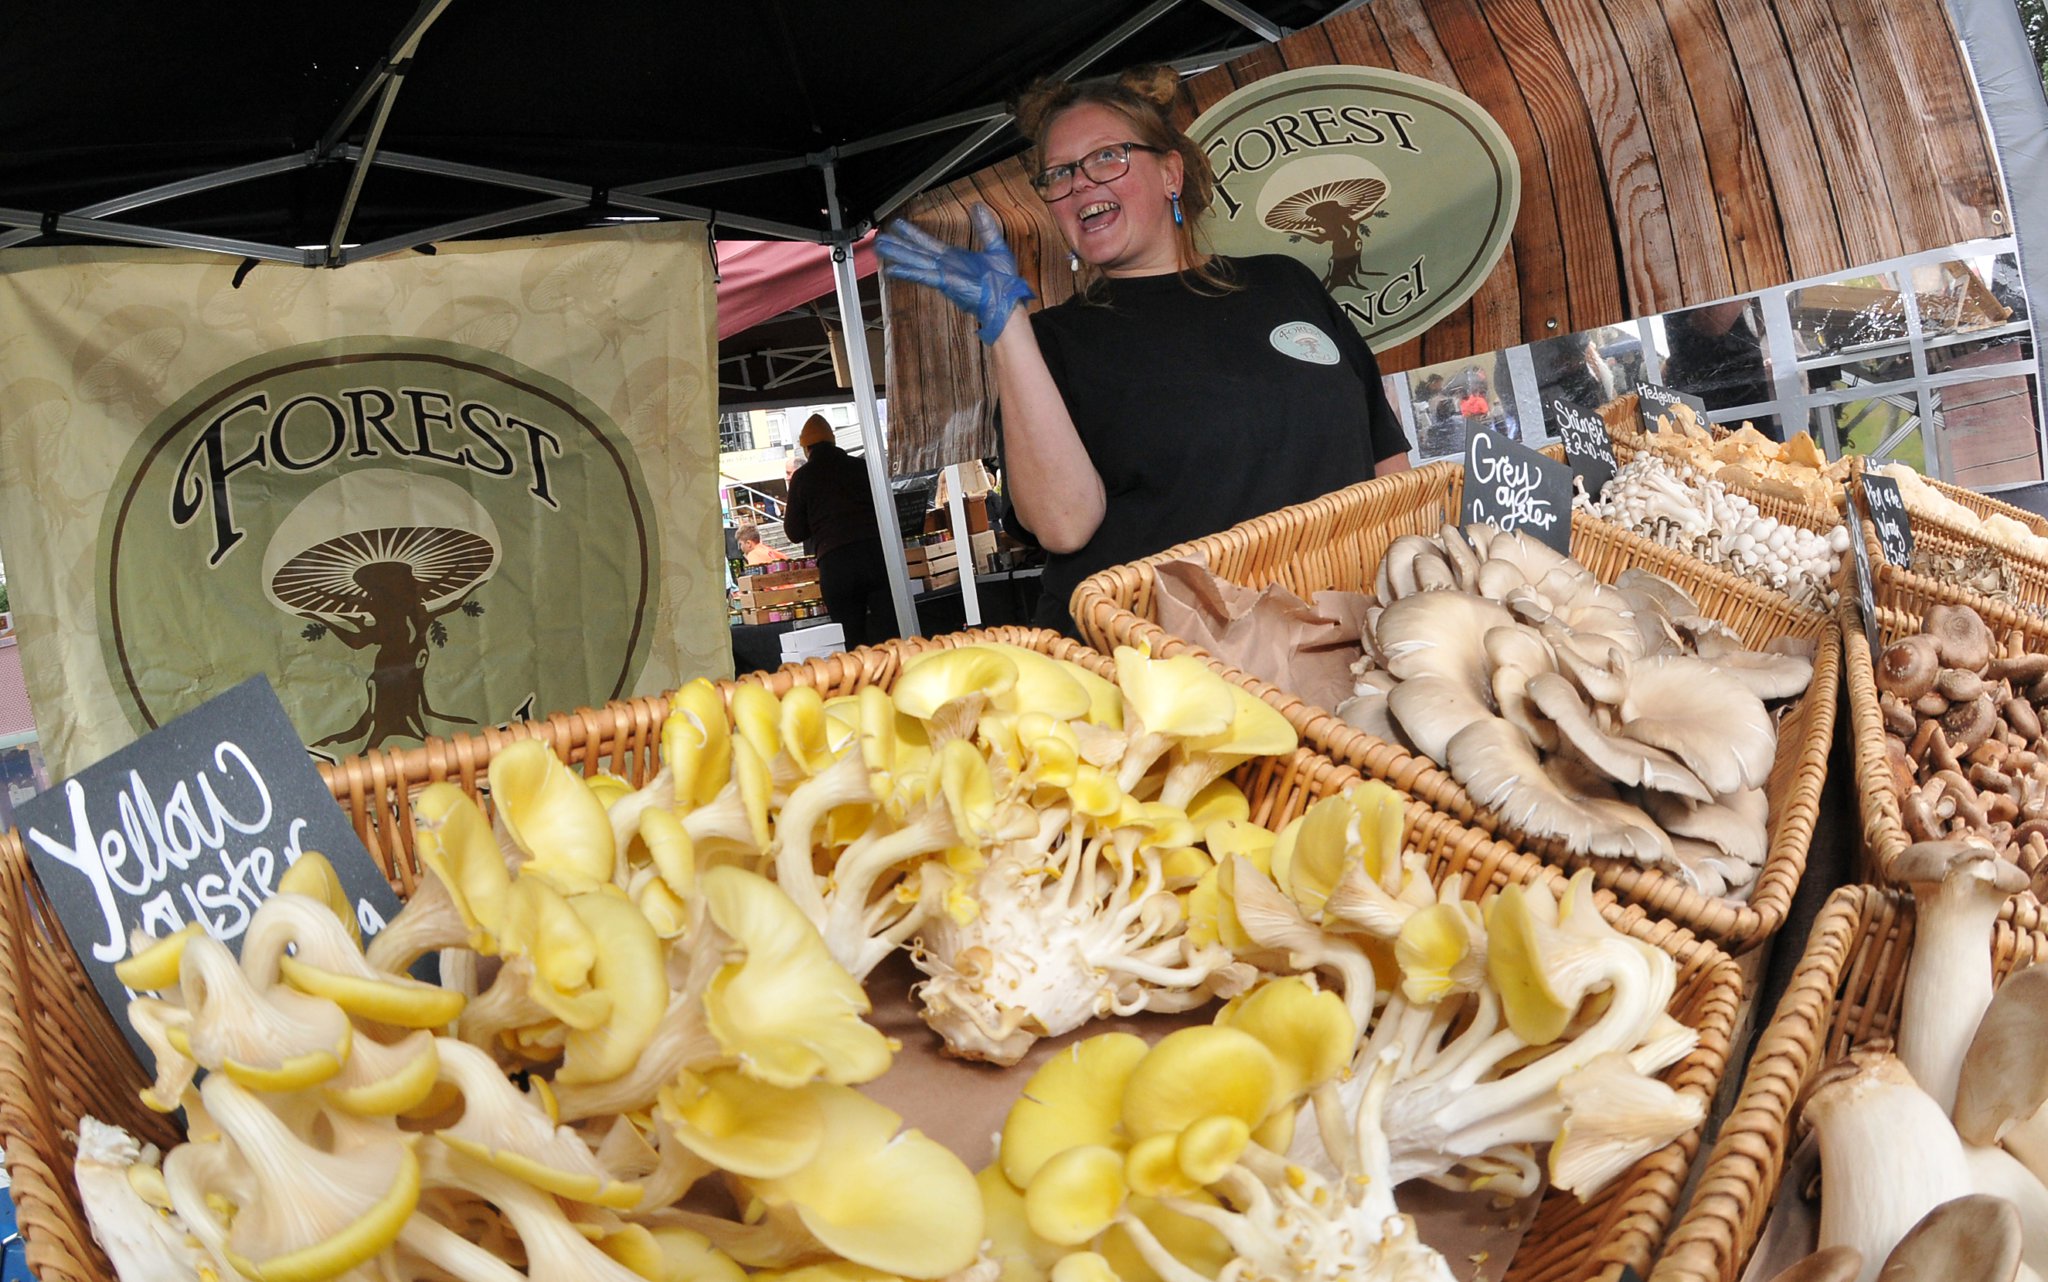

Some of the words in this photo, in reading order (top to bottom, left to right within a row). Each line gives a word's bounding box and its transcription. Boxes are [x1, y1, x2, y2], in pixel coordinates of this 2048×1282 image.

[1205, 107, 1420, 221] FOREST
[1340, 255, 1428, 327] NGI
[1554, 400, 1608, 446] Shimeji
[171, 388, 562, 567] FOREST
[1471, 432, 1543, 506] Grey
[1495, 485, 1558, 533] oyster
[28, 740, 273, 964] Yellow
